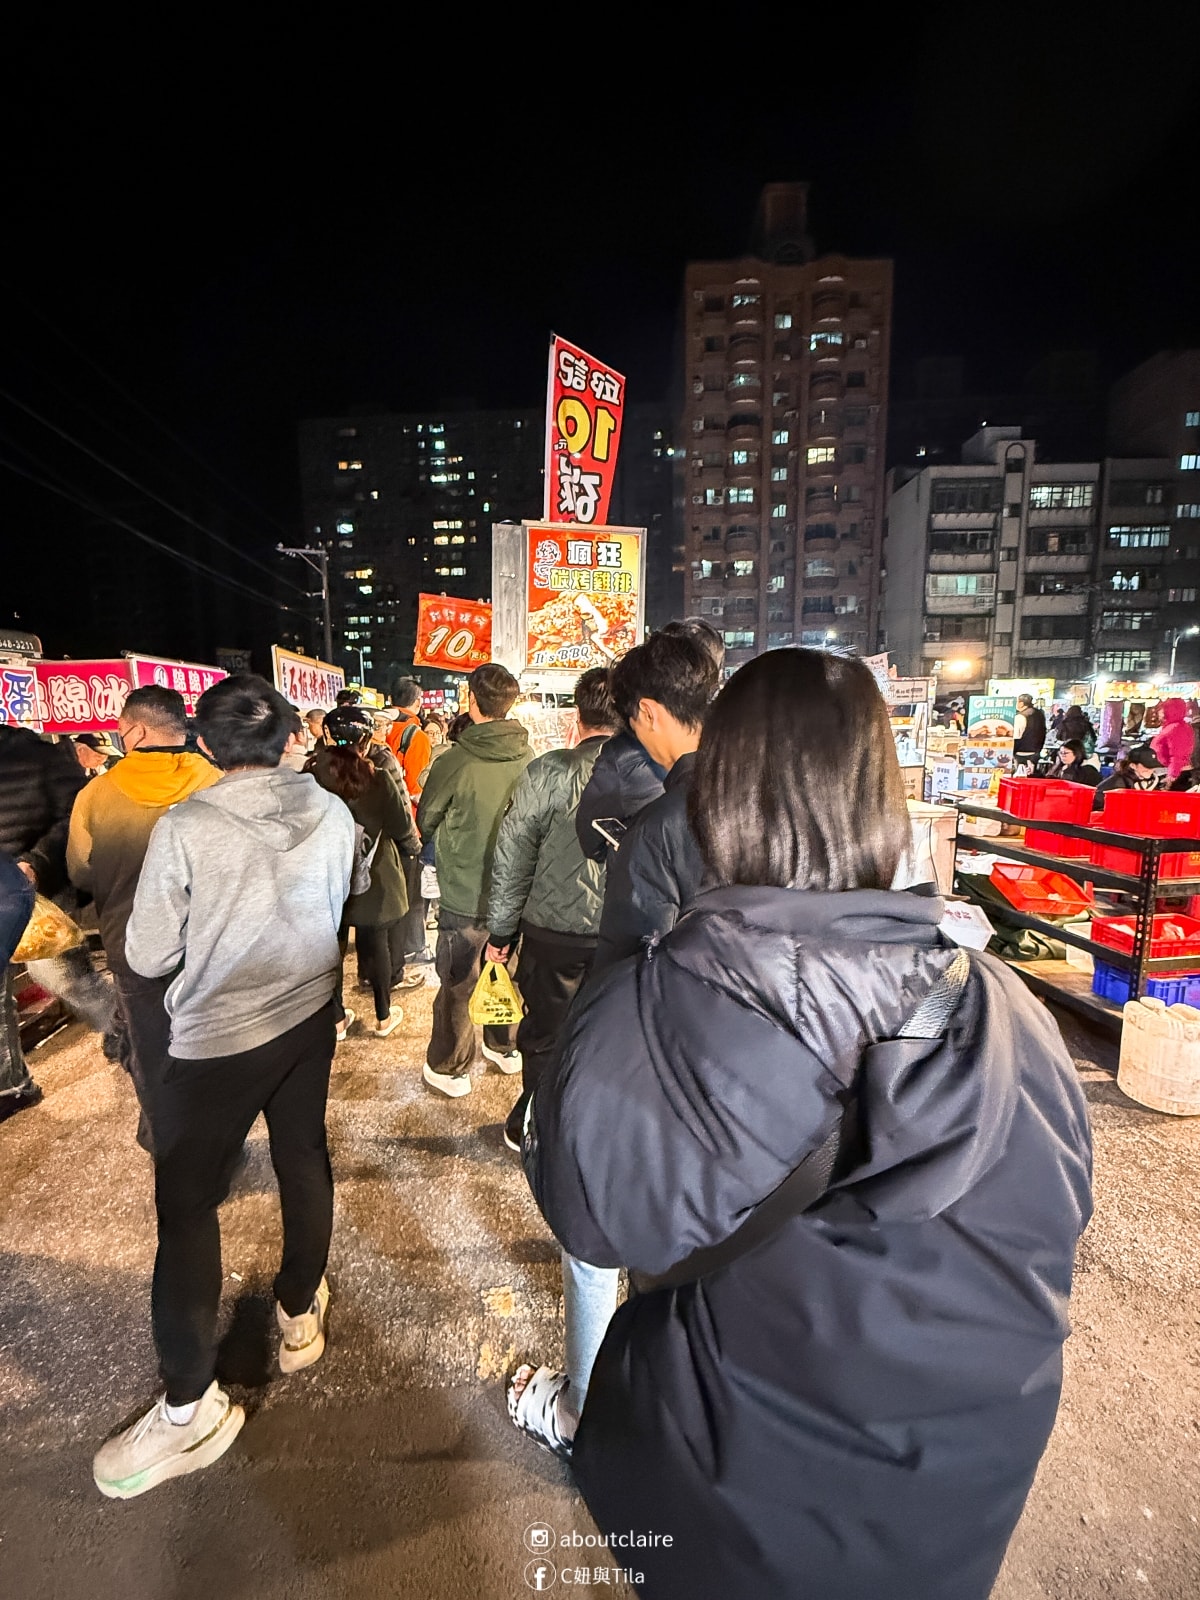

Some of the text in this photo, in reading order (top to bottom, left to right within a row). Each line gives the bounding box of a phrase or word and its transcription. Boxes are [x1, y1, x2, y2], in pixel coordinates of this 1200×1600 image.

[568, 540, 622, 568] 瘋狂
[549, 568, 633, 593] 碳烤雞排
[558, 646, 590, 660] BBQ
[0, 670, 33, 724] 蛋
